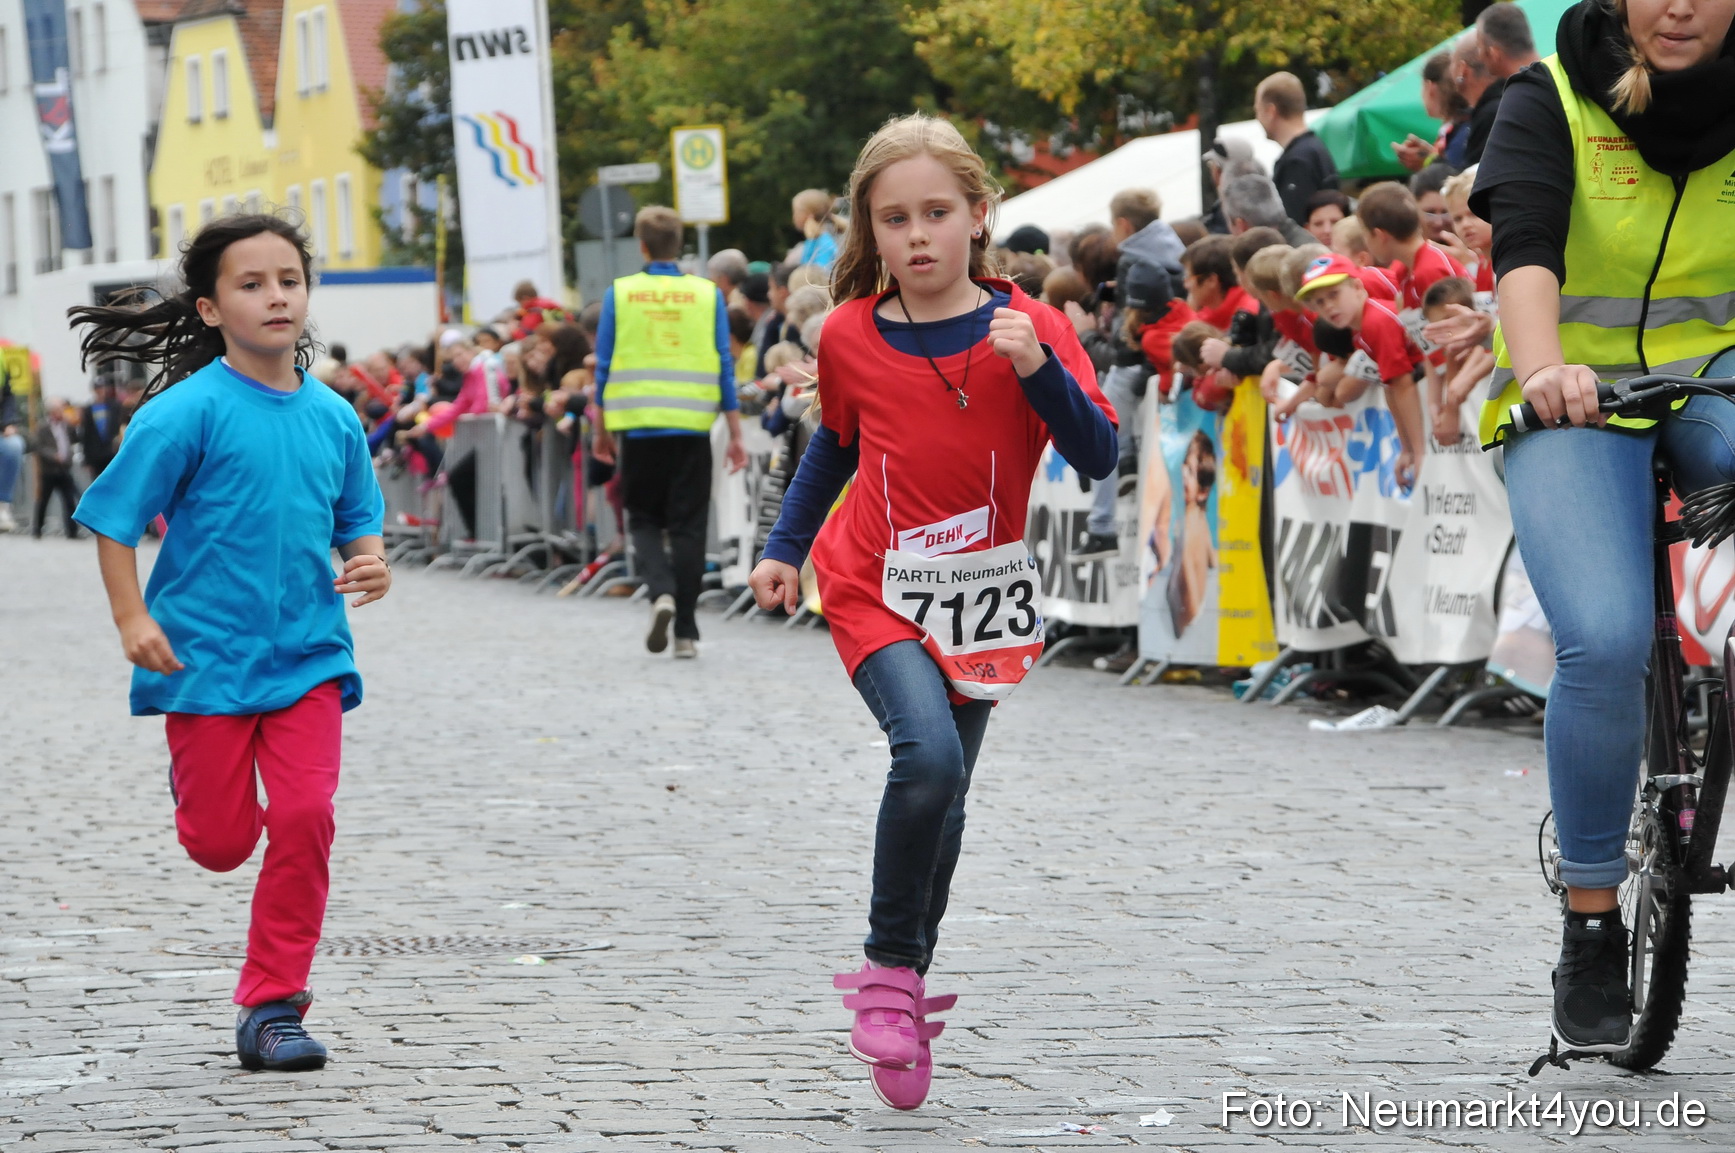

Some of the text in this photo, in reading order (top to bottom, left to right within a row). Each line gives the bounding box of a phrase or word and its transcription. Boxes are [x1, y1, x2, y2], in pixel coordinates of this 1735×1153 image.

[628, 291, 696, 304] HELFER
[925, 524, 964, 549] DEHN
[887, 559, 1023, 584] PARTL Neumarkt
[901, 580, 1036, 647] 7123
[955, 660, 998, 678] Lisa
